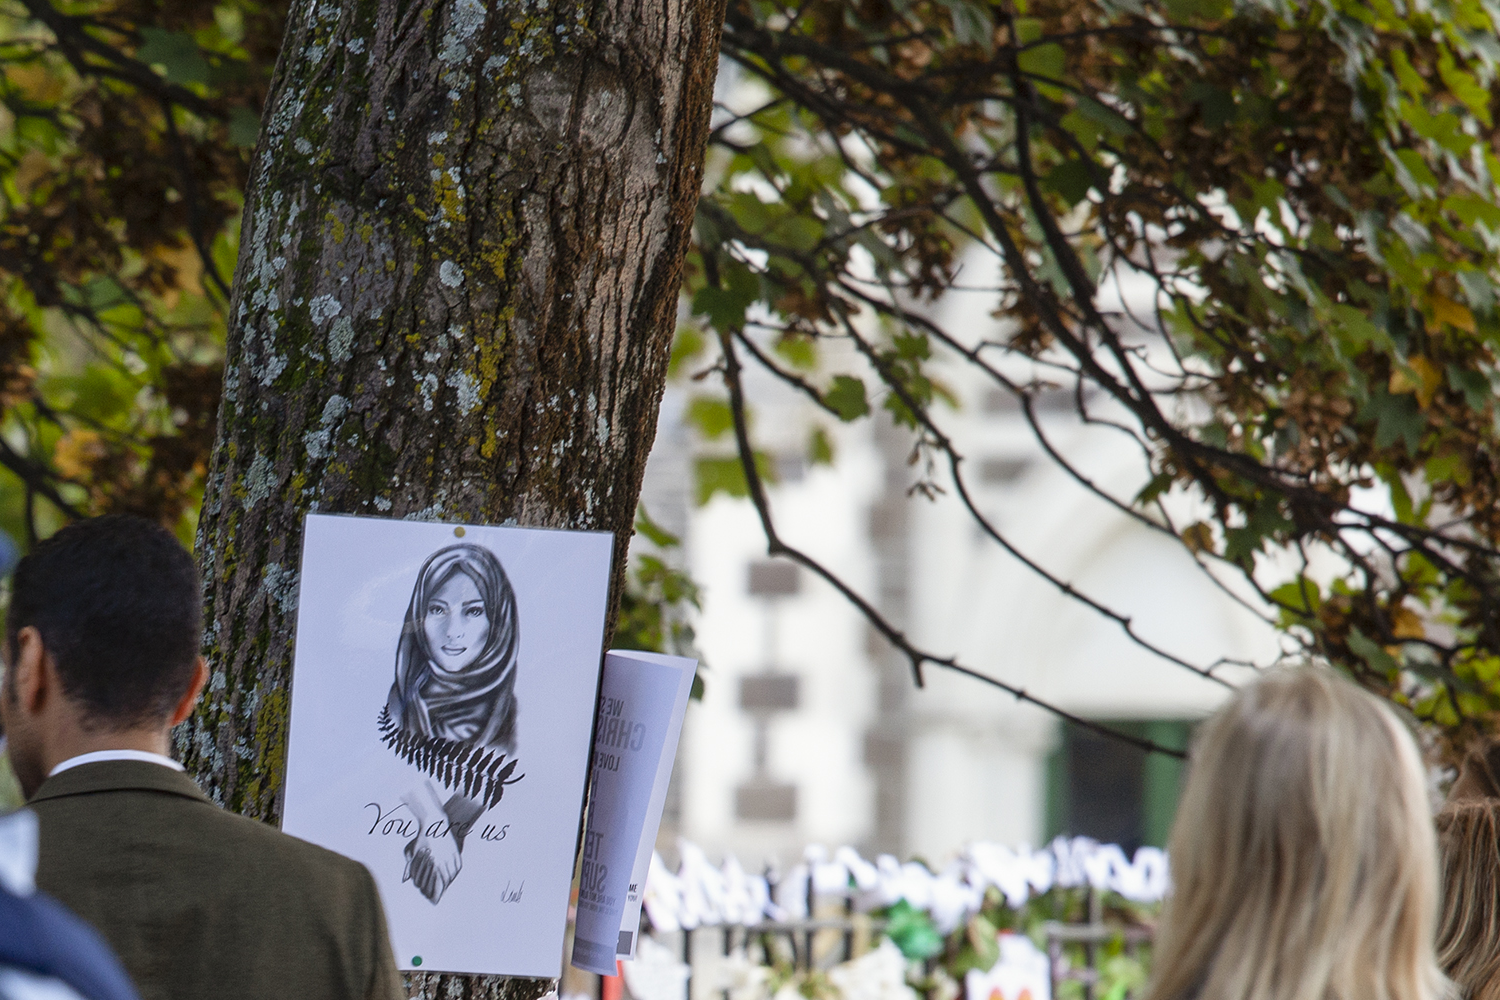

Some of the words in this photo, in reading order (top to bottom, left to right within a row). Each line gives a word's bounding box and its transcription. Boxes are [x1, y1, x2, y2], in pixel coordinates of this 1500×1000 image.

[364, 803, 417, 838] You
[425, 818, 474, 839] are
[480, 823, 511, 842] us
